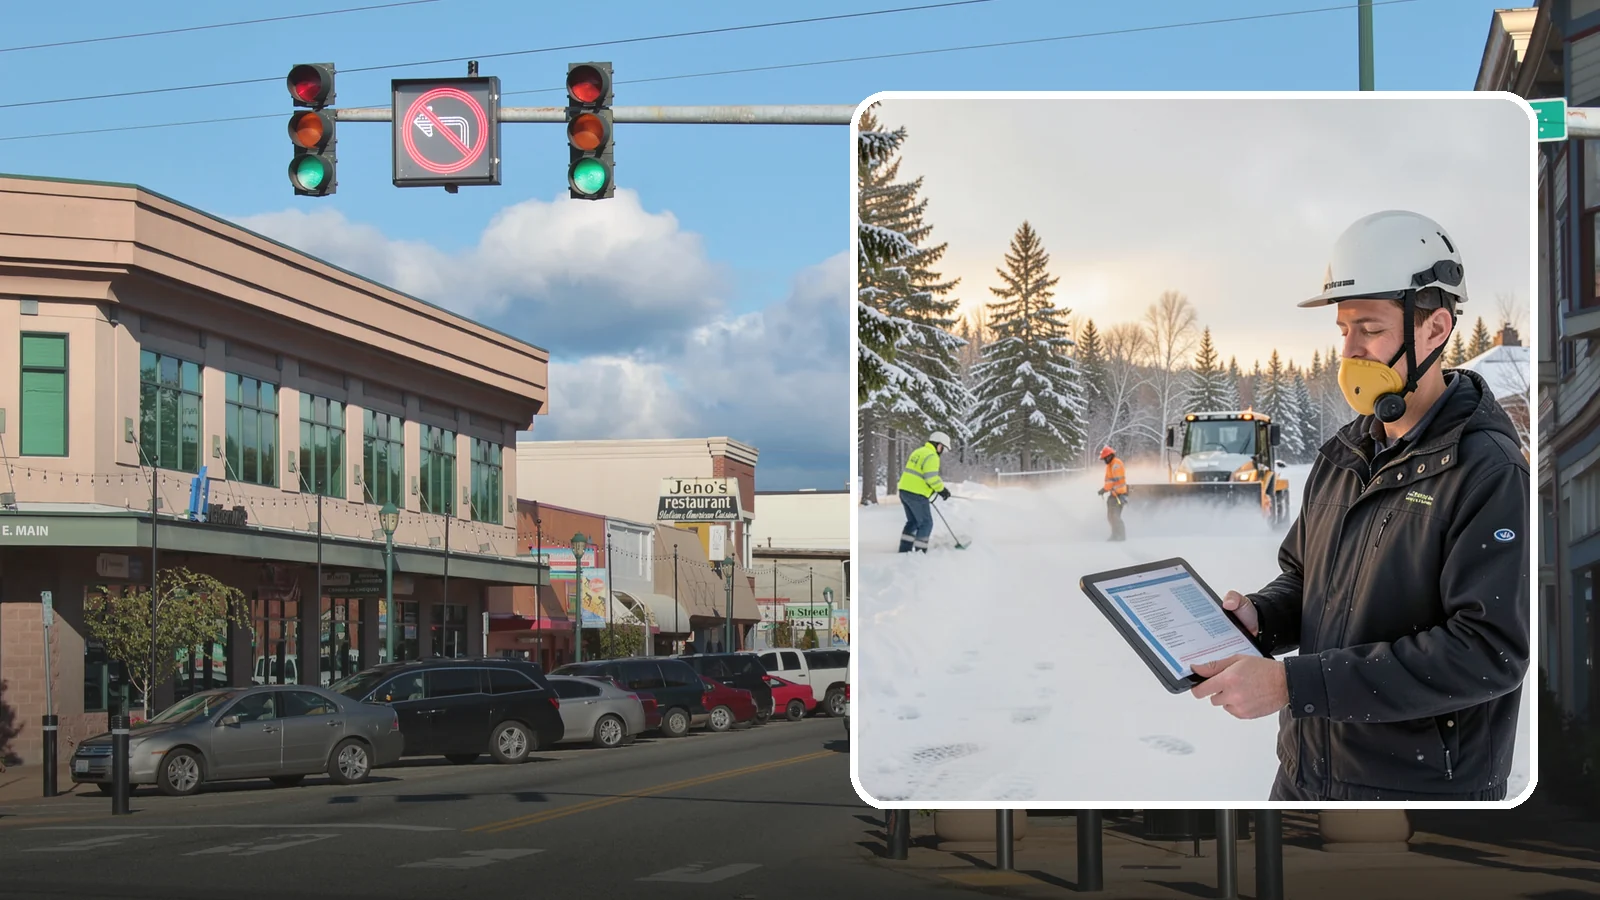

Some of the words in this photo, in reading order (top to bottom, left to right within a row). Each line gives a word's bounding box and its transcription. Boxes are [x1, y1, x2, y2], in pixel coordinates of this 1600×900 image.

[669, 480, 728, 494] Jeno's
[665, 496, 731, 508] restaurant
[658, 510, 681, 519] Italian
[685, 510, 714, 519] American
[715, 510, 737, 519] Cuisine
[2, 525, 13, 536] E.
[15, 525, 49, 536] MAIN
[797, 607, 828, 617] Street
